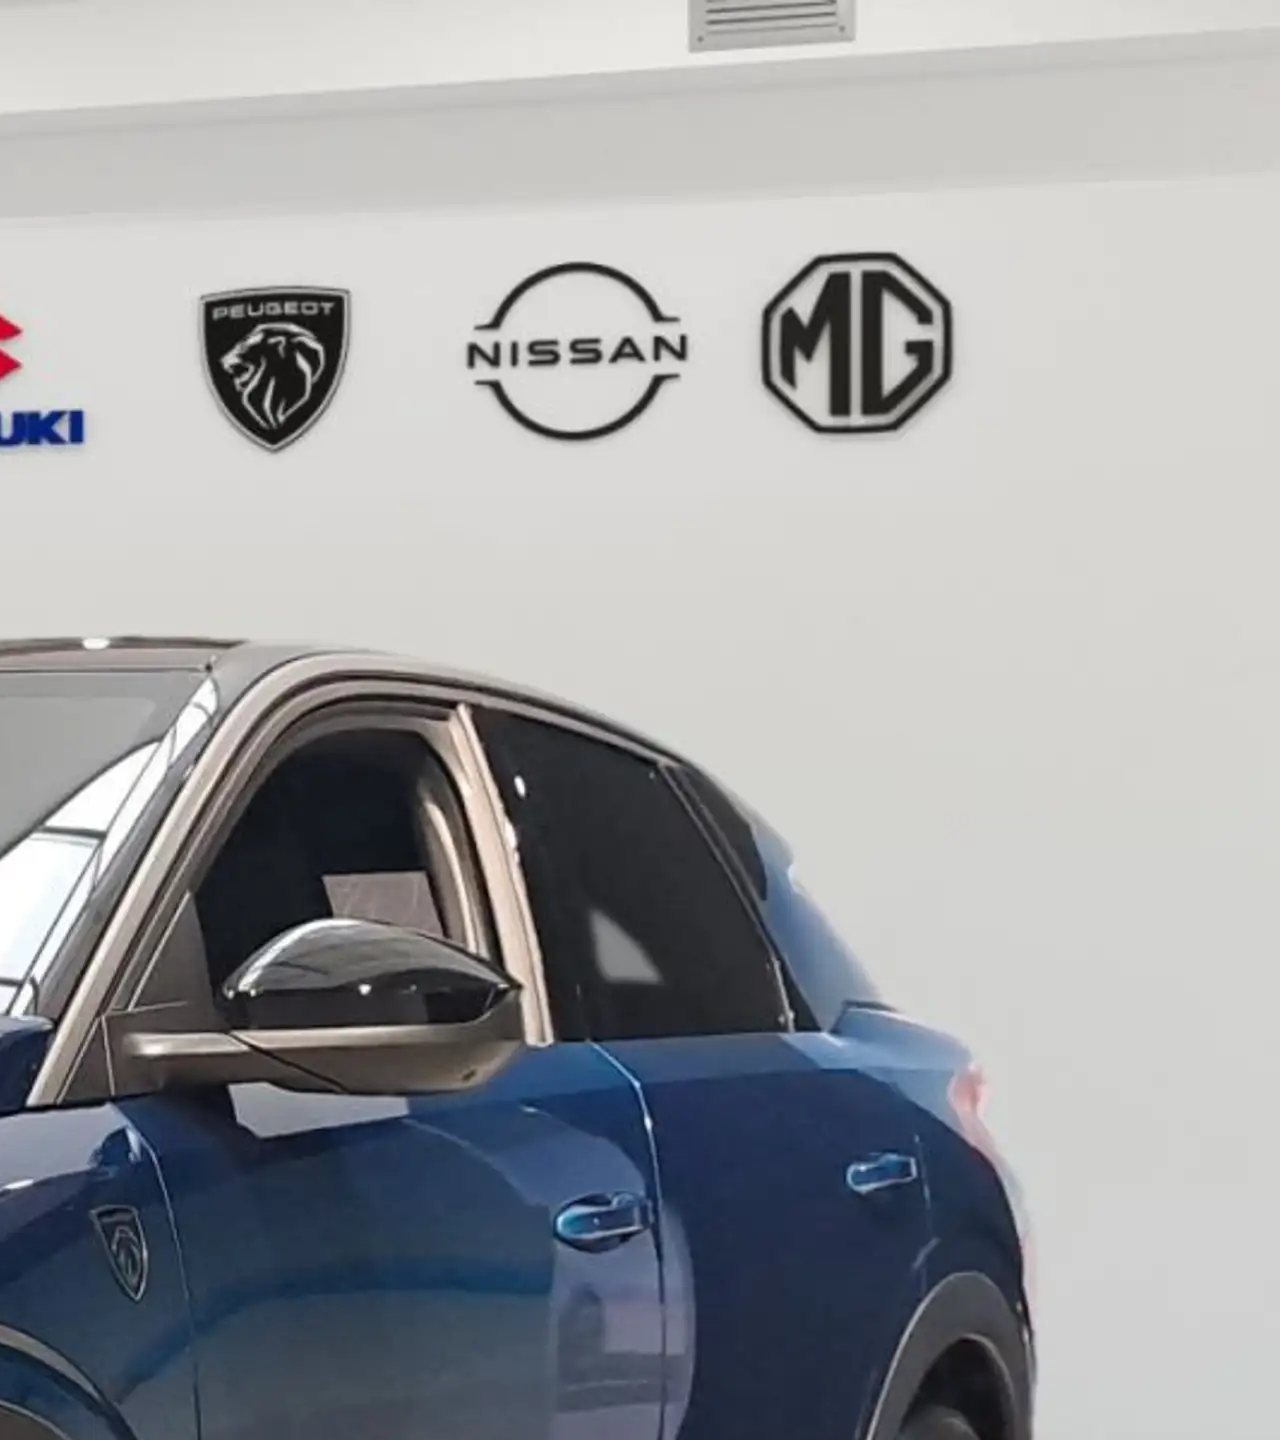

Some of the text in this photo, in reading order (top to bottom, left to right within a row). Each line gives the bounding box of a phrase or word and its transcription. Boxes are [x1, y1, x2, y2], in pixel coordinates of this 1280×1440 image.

[211, 301, 336, 321] PEUGEOT
[467, 332, 688, 369] NISSAN
[780, 269, 934, 417] MG
